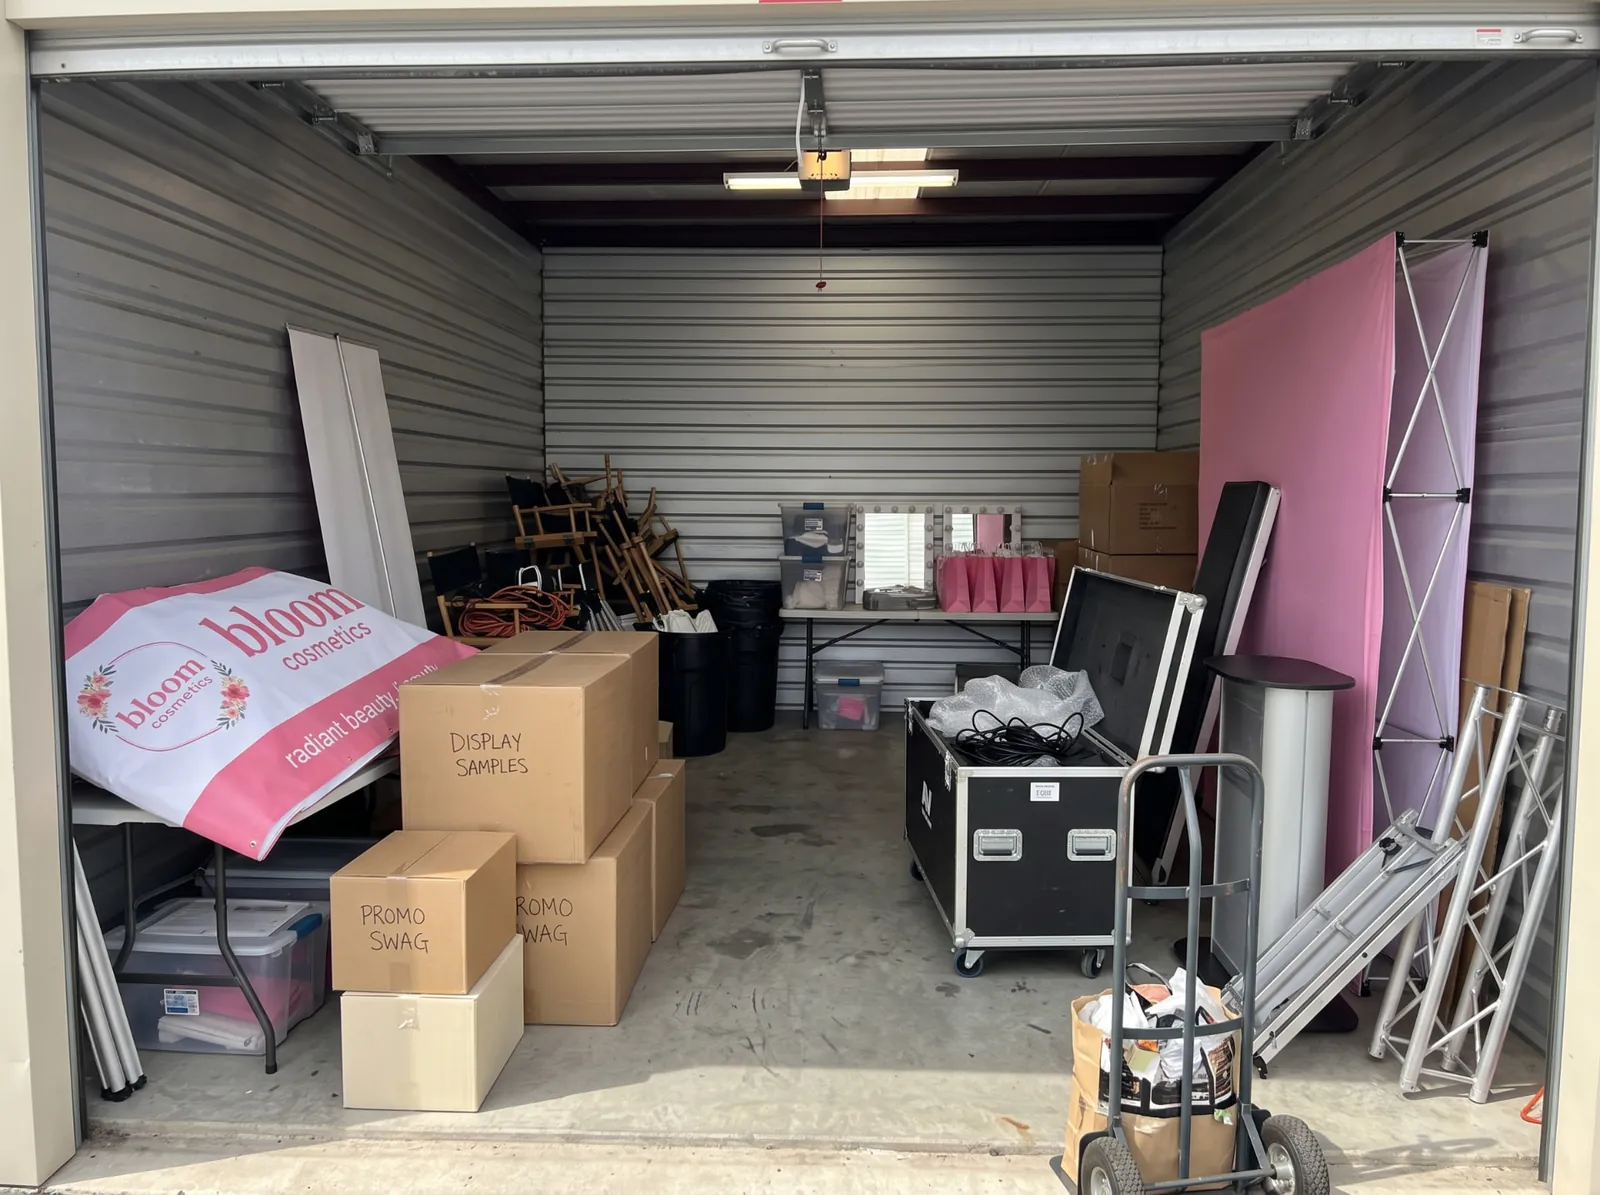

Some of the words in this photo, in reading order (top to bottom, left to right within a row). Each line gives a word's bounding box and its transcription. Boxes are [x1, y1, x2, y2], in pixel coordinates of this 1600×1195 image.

[198, 588, 366, 658] bloom
[282, 621, 372, 671] cosmetics
[115, 658, 206, 730] bloom
[151, 676, 213, 729] cosmetics
[285, 721, 349, 769] radiant
[449, 732, 522, 753] DISPLAY
[455, 758, 529, 777] SAMPLES
[361, 904, 426, 926] PROMO
[516, 896, 574, 917] ROMO
[369, 930, 429, 953] SWAG
[516, 923, 568, 946] WAG
